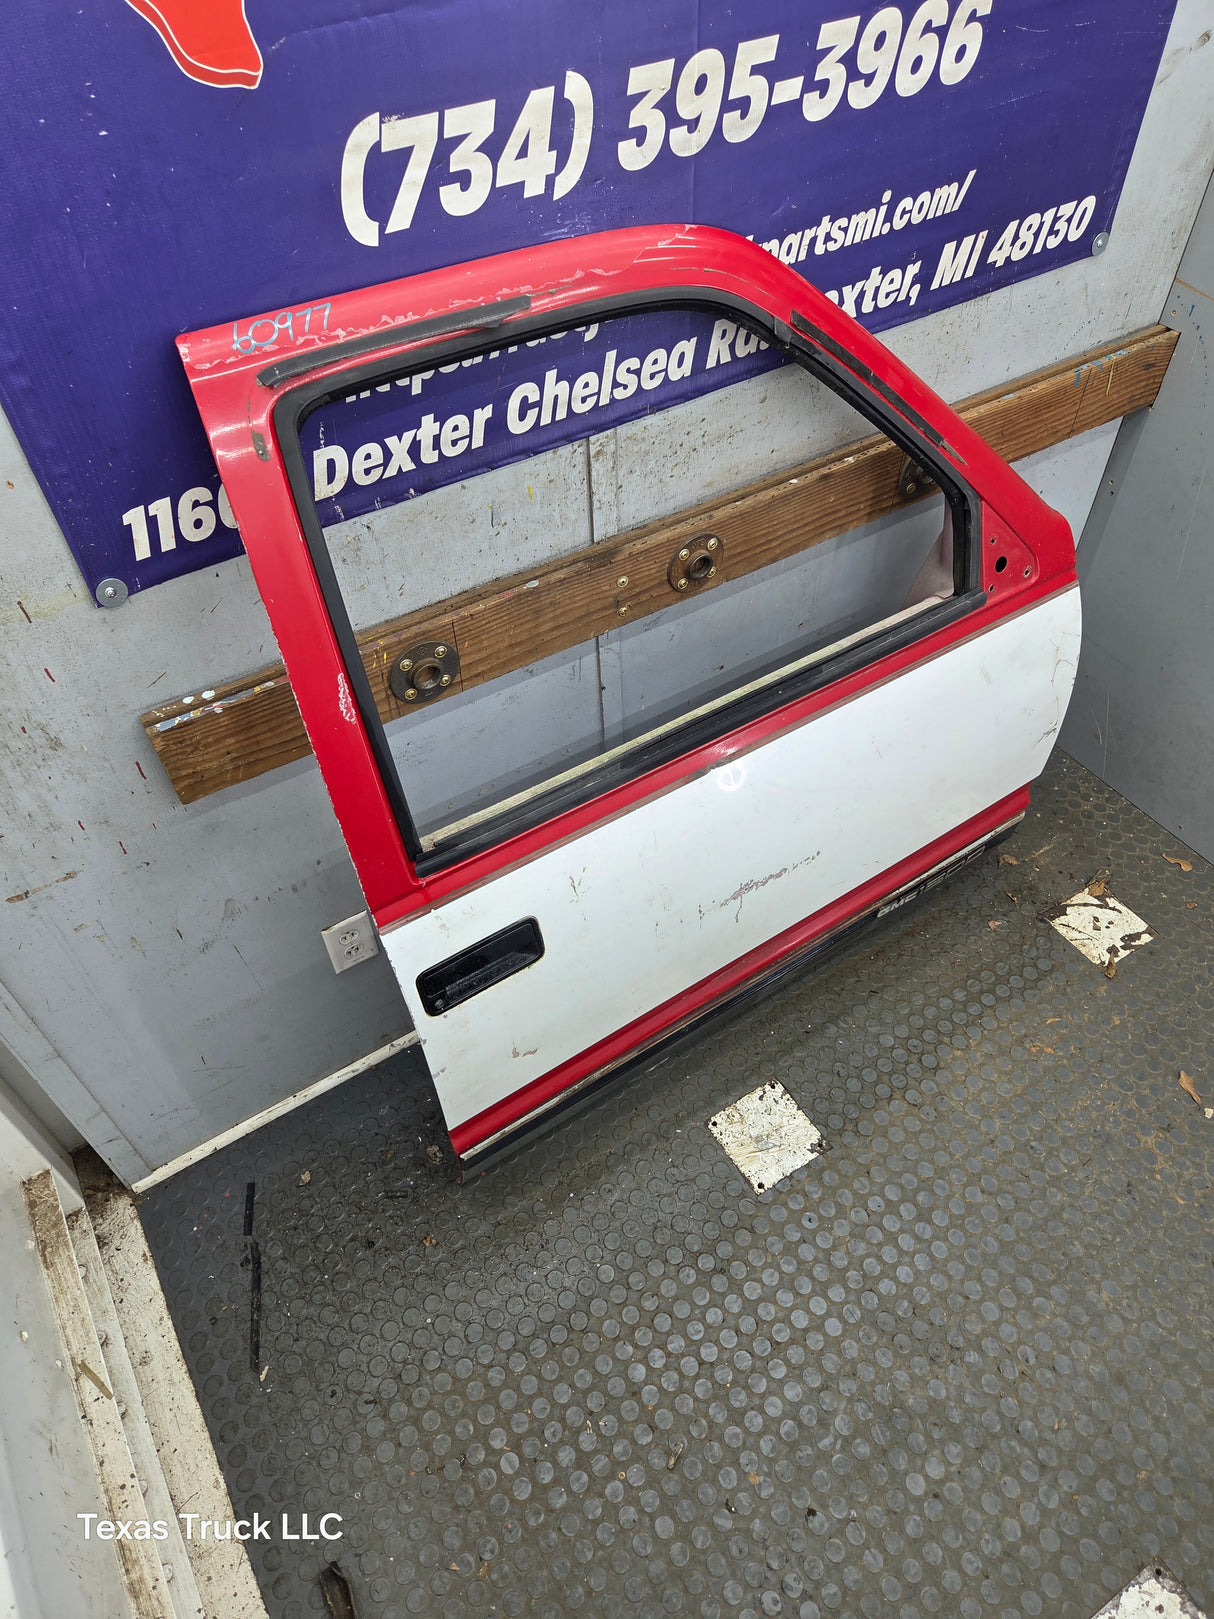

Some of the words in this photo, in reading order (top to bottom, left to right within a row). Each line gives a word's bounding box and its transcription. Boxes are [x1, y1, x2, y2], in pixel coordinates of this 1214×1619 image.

[340, 68, 594, 248] (734)
[617, 0, 994, 172] 395-3966
[746, 168, 978, 266] artsmi.com/
[232, 302, 332, 354] 60977
[312, 403, 495, 502] Dexter
[506, 336, 698, 436] Chelsea
[824, 260, 922, 319] xter,
[929, 229, 989, 291] MI
[986, 194, 1097, 269] 48130
